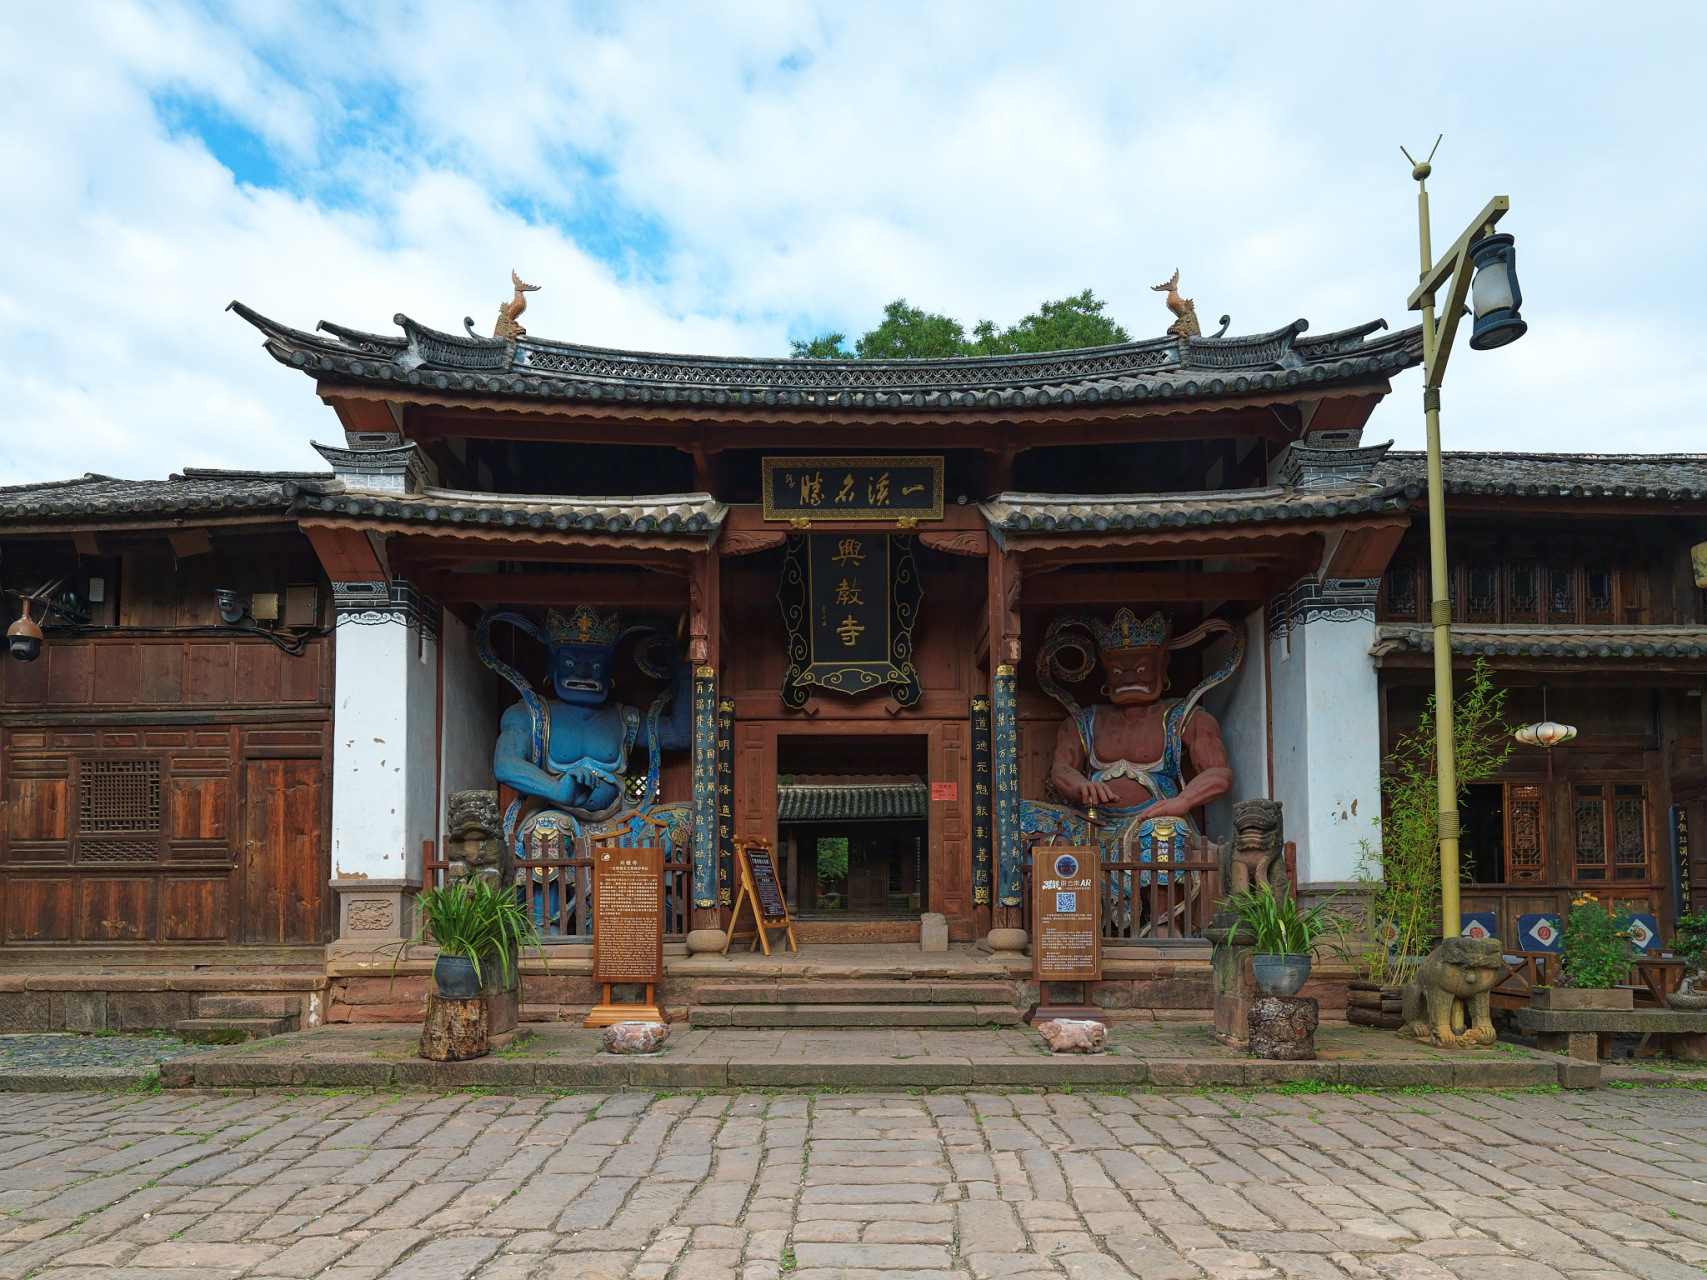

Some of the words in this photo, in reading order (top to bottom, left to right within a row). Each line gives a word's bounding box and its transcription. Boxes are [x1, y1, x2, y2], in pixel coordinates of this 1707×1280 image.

[831, 538, 866, 647] 興教寺
[1080, 878, 1092, 887] AR
